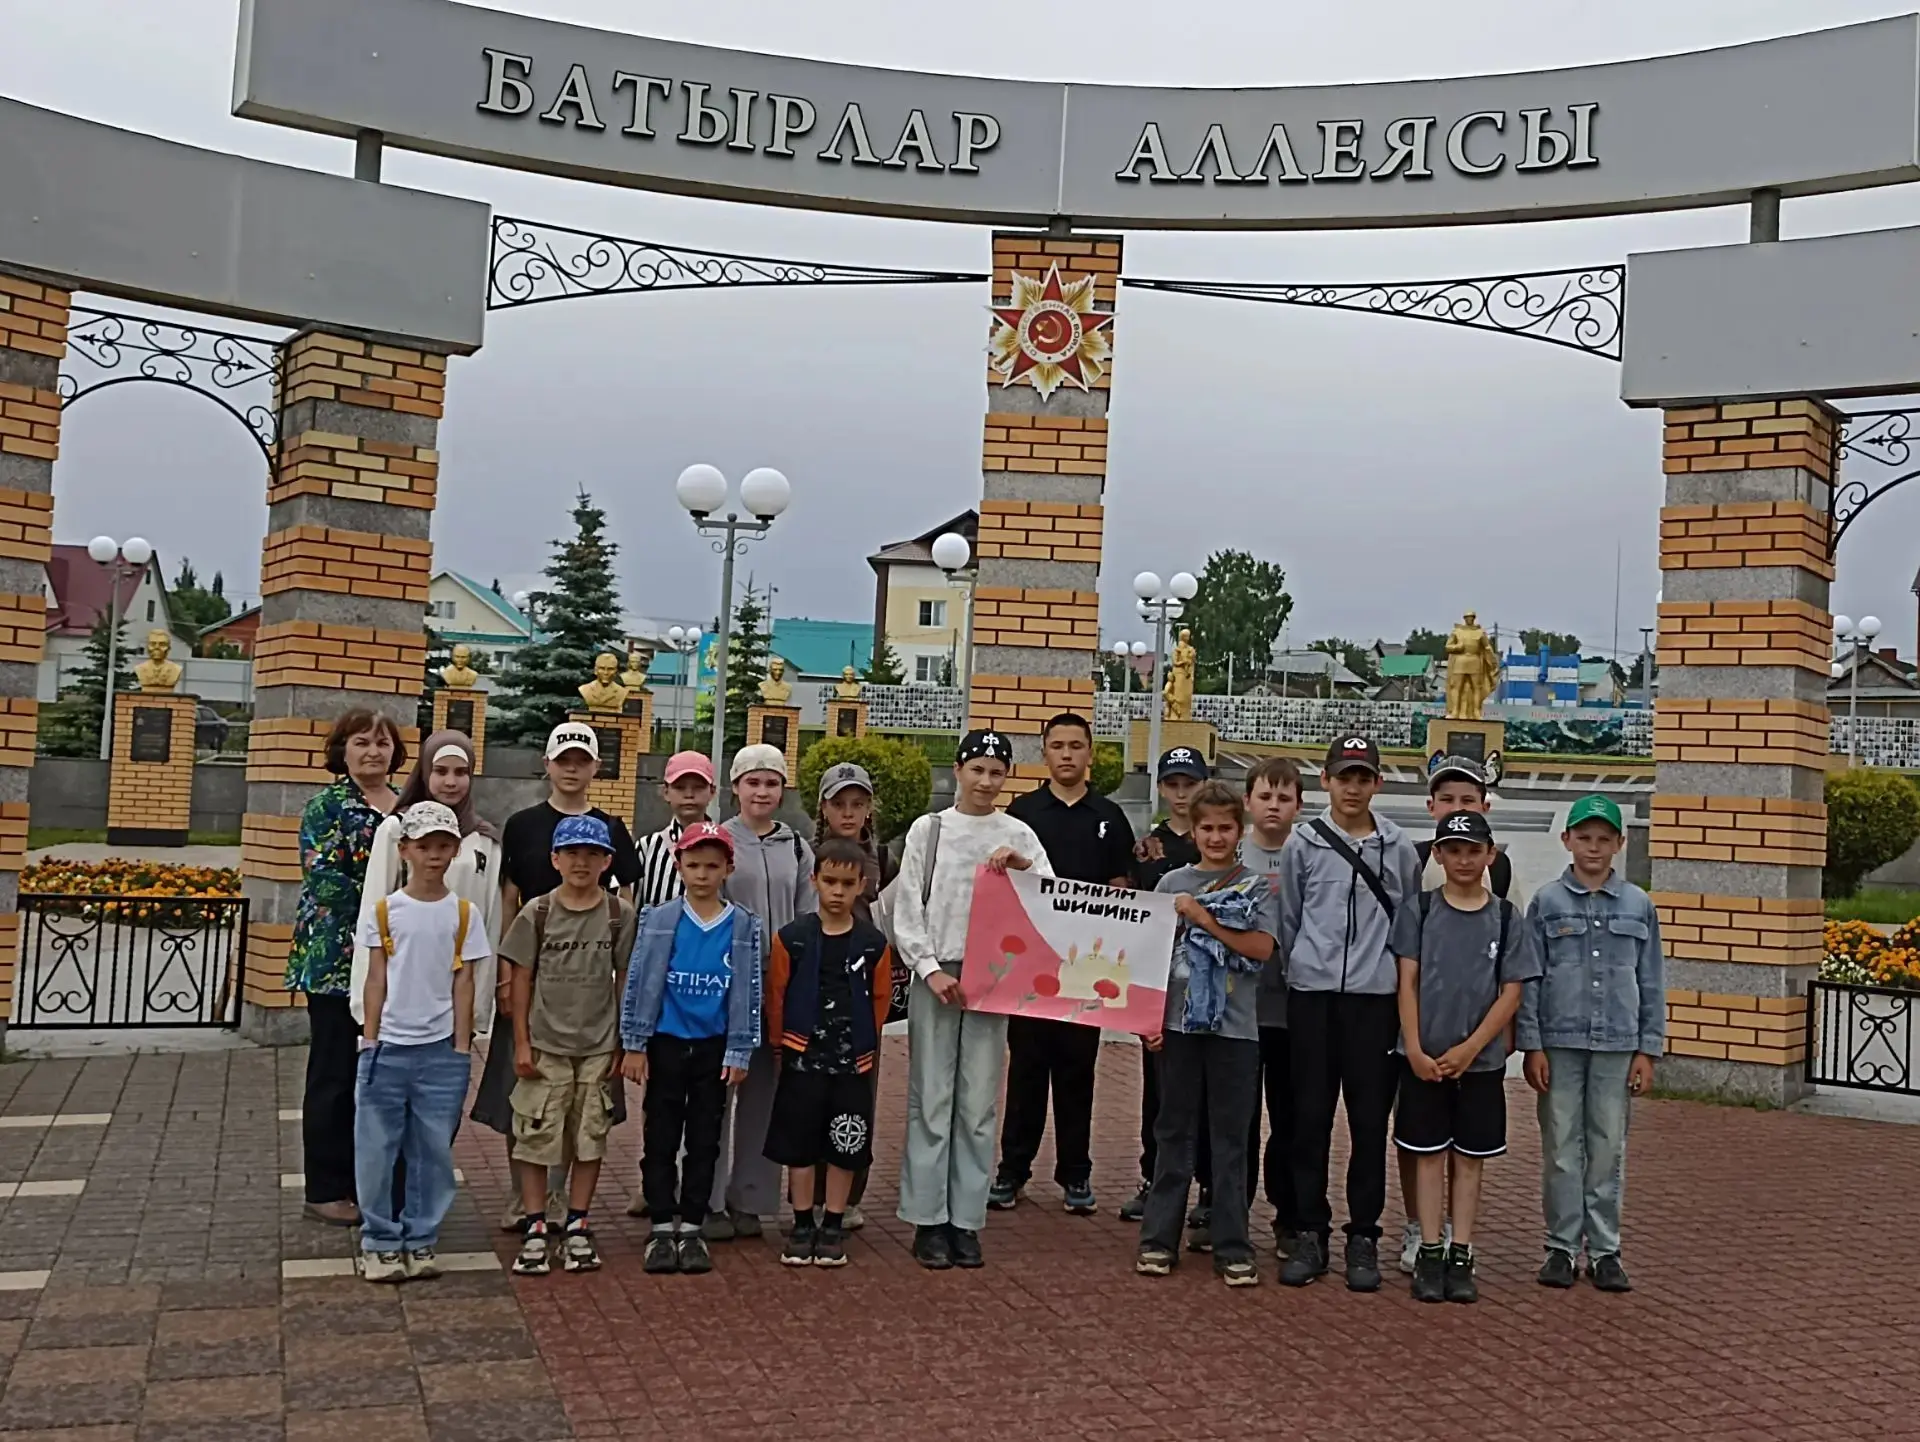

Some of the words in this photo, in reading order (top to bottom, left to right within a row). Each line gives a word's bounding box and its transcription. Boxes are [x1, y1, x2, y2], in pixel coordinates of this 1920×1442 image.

[478, 47, 1002, 173] БАТЫРЛАР
[1115, 102, 1600, 183] АЛЛЕЯСЫ
[1166, 757, 1194, 765] TOYOTA
[1040, 877, 1137, 900] ПОМНИМ
[1052, 897, 1151, 924] ШИШИНЕР
